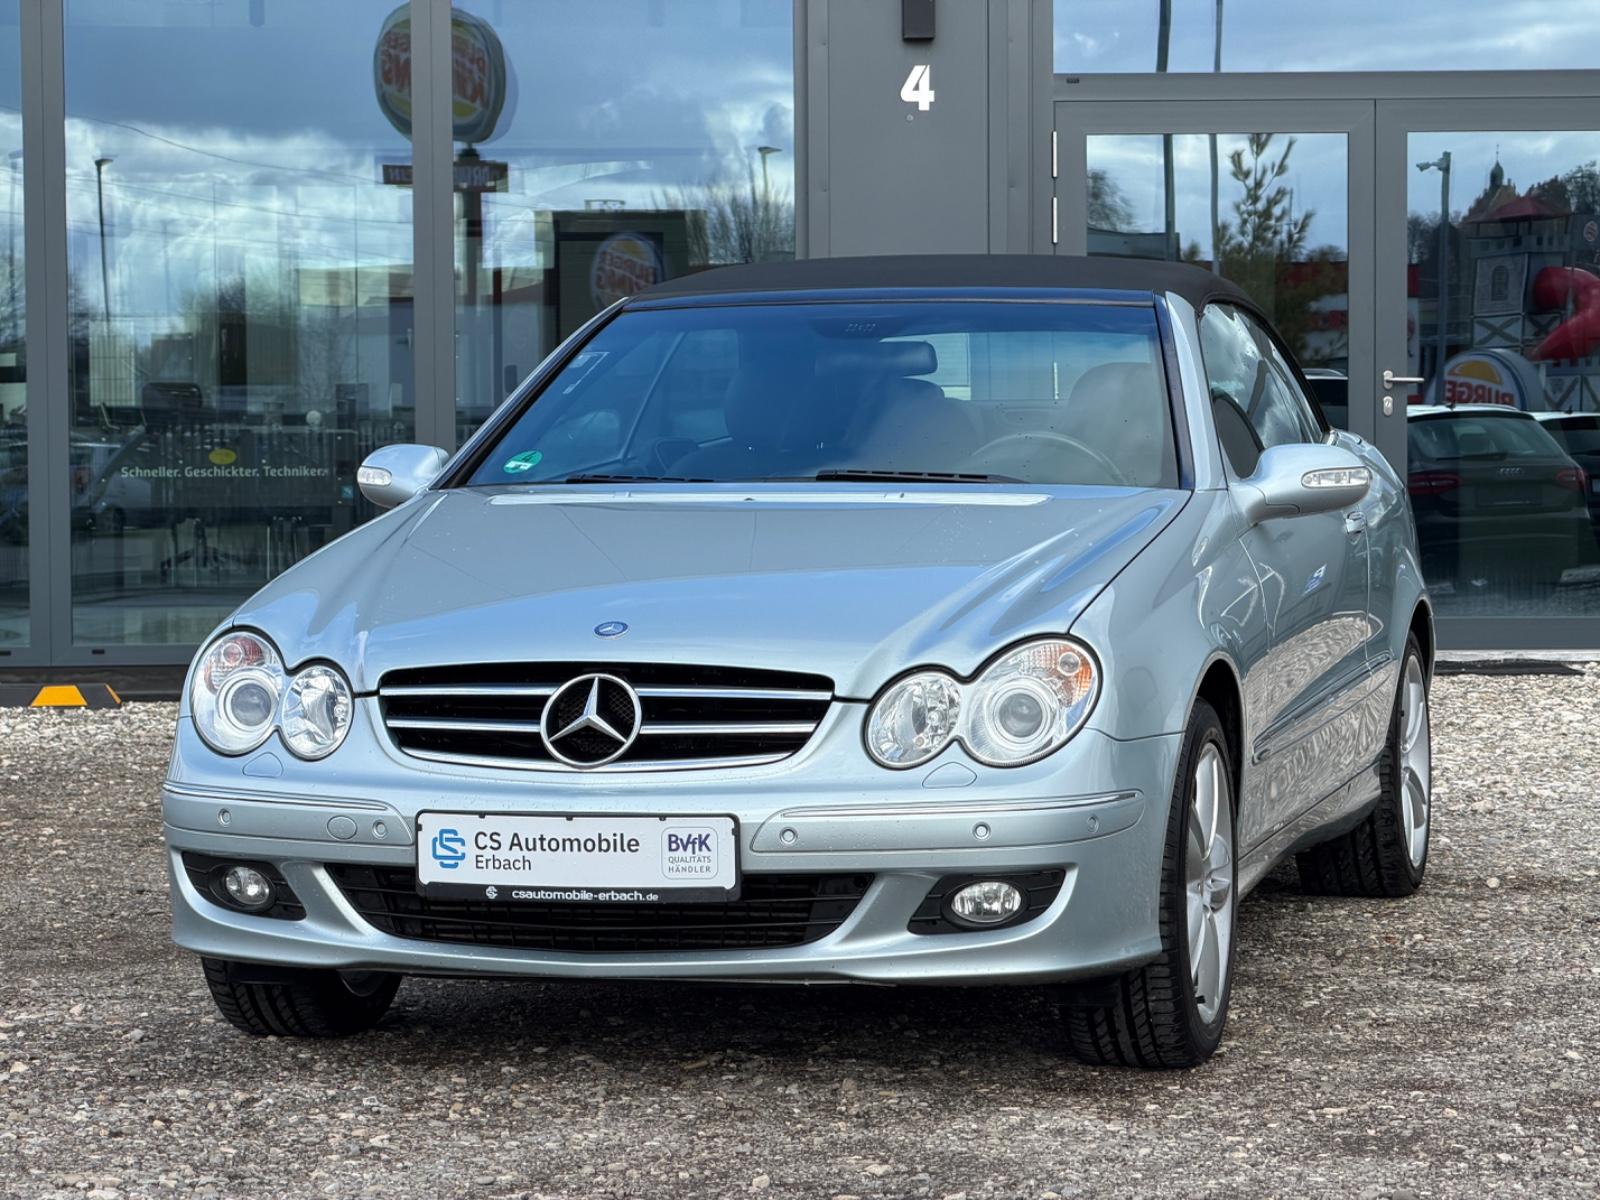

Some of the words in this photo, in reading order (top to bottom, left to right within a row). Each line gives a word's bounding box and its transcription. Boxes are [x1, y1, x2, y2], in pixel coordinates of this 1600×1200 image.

[900, 64, 935, 111] 4
[121, 466, 181, 478] Schneller.
[184, 466, 260, 478] Geschickter.
[475, 831, 502, 851] CS
[508, 832, 640, 853] Automobile
[475, 854, 532, 871] Erbach
[668, 865, 712, 874] HÄNDLER
[512, 889, 659, 902] csautomobile-erbach.de
